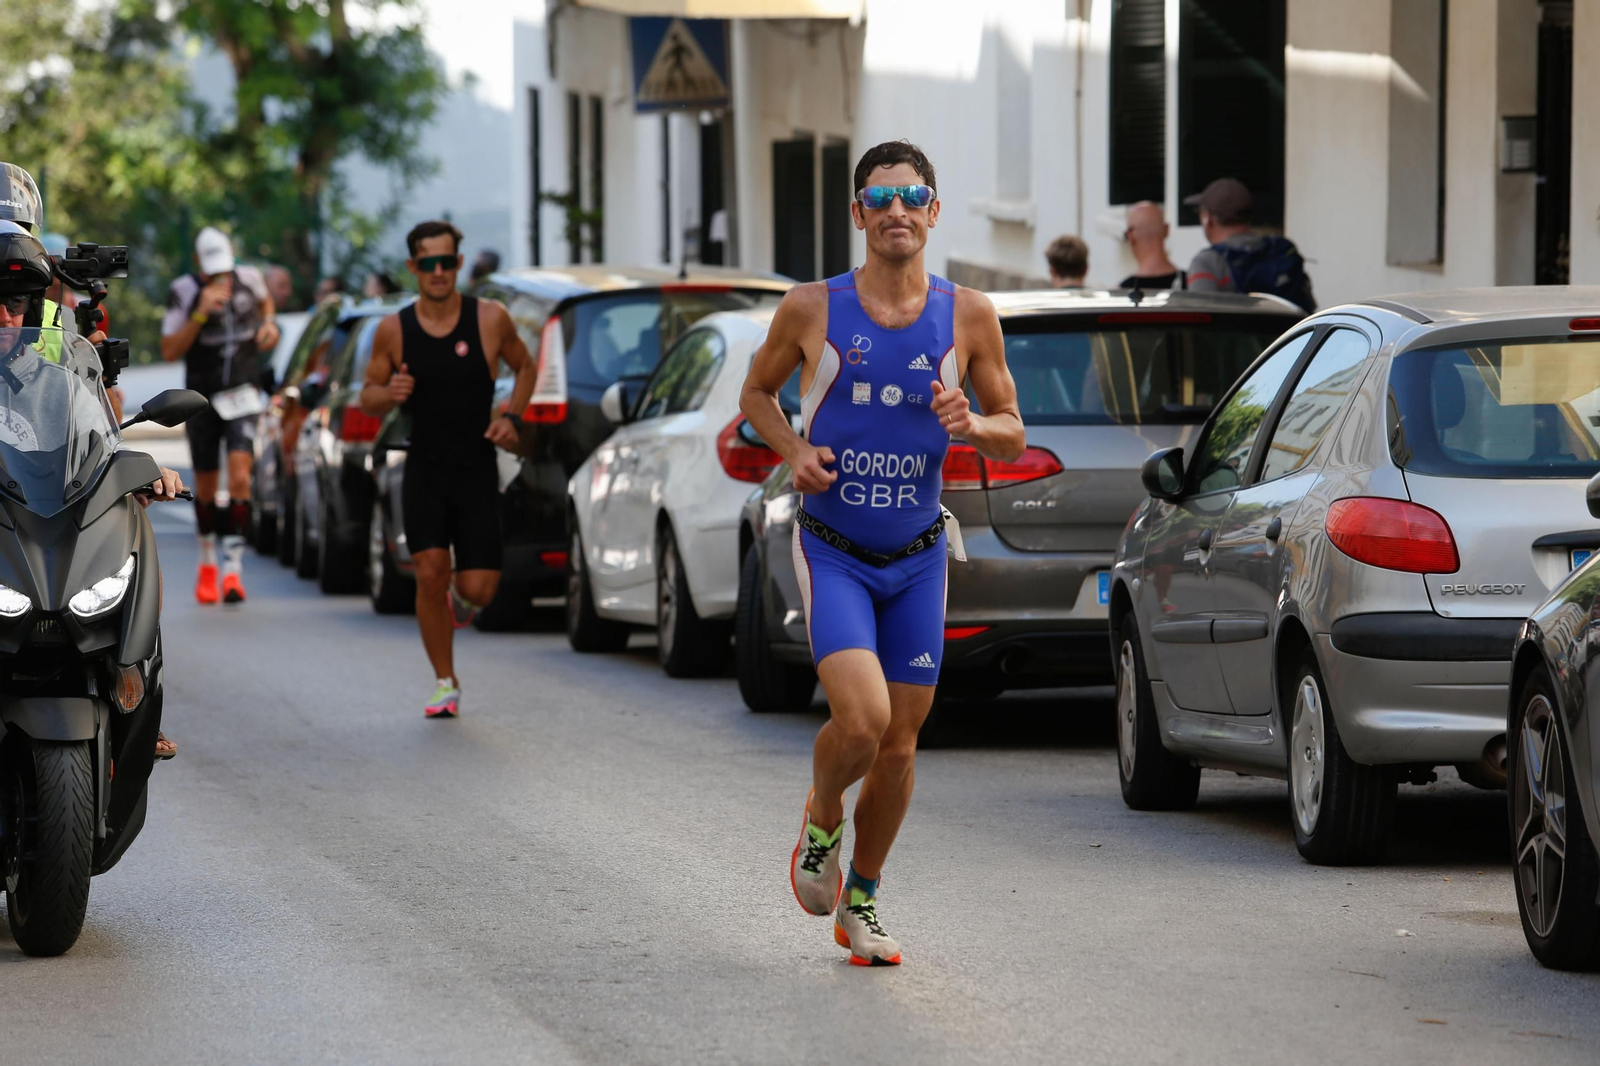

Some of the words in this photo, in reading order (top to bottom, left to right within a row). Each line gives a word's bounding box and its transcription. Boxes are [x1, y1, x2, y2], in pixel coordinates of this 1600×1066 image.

[908, 363, 932, 371] adidas
[907, 393, 923, 404] GE
[841, 448, 927, 479] GORDON
[840, 481, 919, 508] GBR
[1440, 583, 1526, 595] PEUGEOT
[908, 660, 936, 668] adidas
